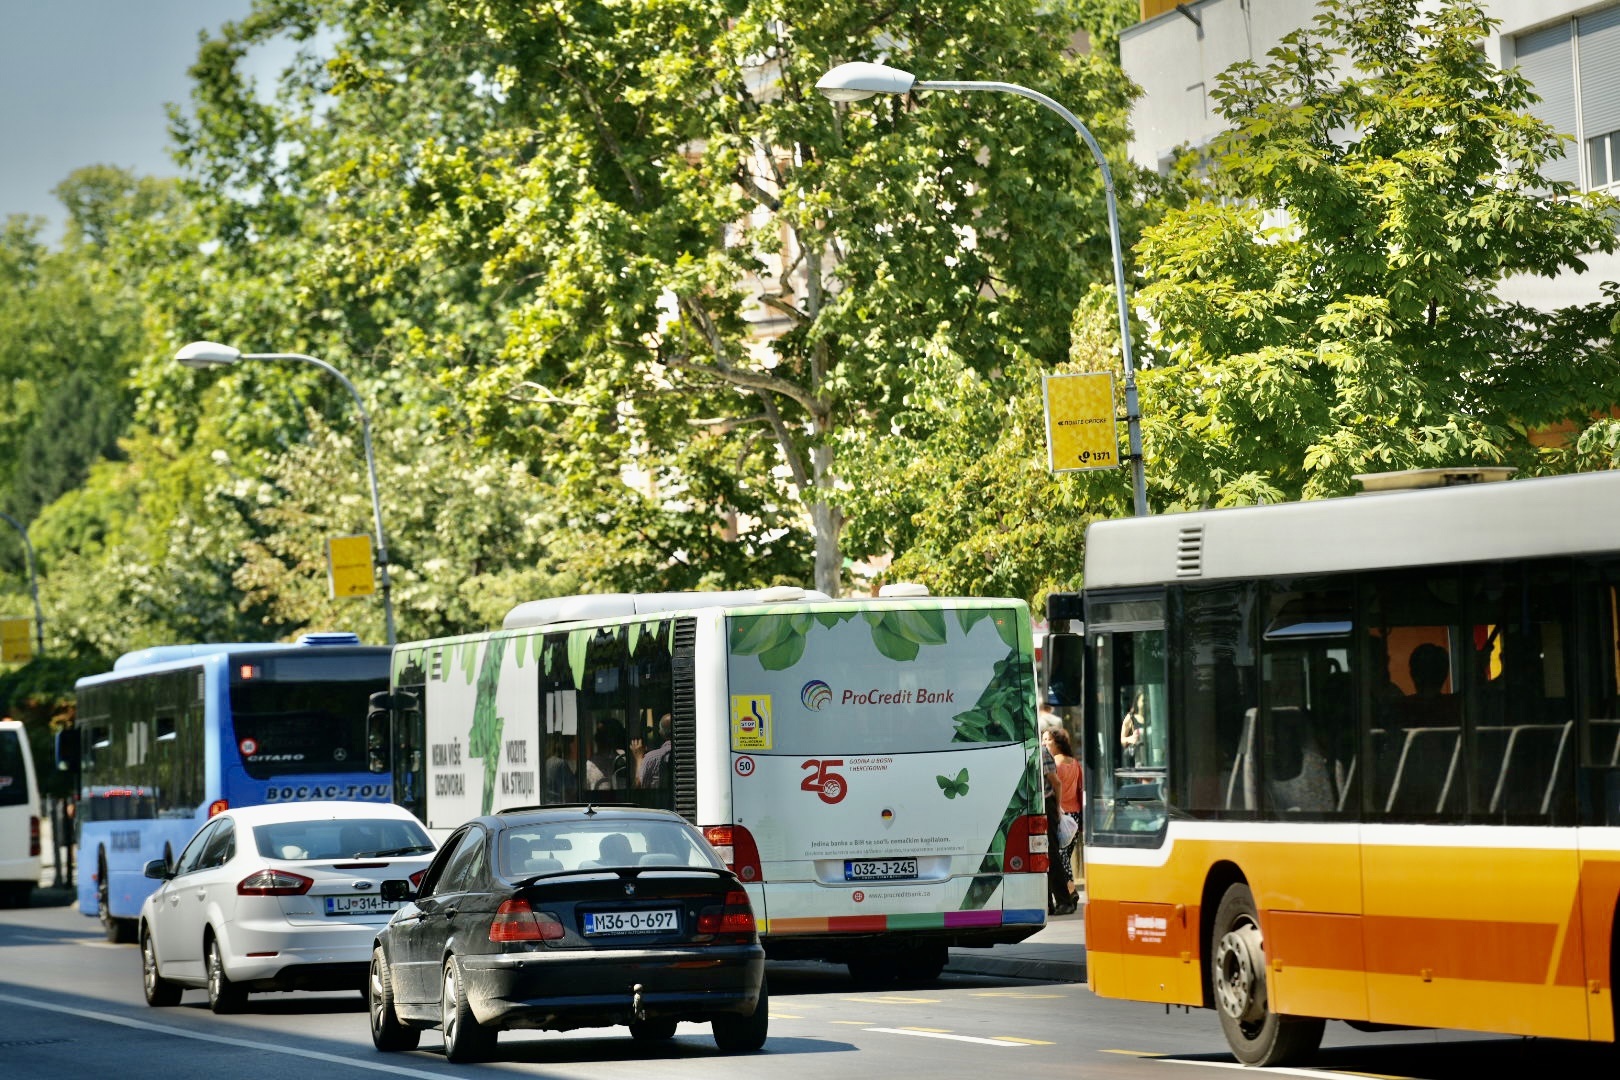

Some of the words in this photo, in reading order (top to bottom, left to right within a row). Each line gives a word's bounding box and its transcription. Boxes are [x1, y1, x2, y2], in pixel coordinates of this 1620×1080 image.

[1093, 452, 1110, 460] 1371
[842, 689, 912, 705] ProCredit
[915, 688, 955, 704] Bank
[248, 754, 305, 762] CITARO
[432, 744, 448, 766] NEMA
[448, 737, 461, 766] VIŠE
[506, 740, 527, 764] VOZITE
[739, 761, 750, 771] 50
[502, 772, 510, 795] NA
[511, 771, 534, 799] STRUJU!
[801, 759, 847, 805] 25
[266, 785, 388, 800] BOCAC-TOU
[337, 898, 351, 911] LJ
